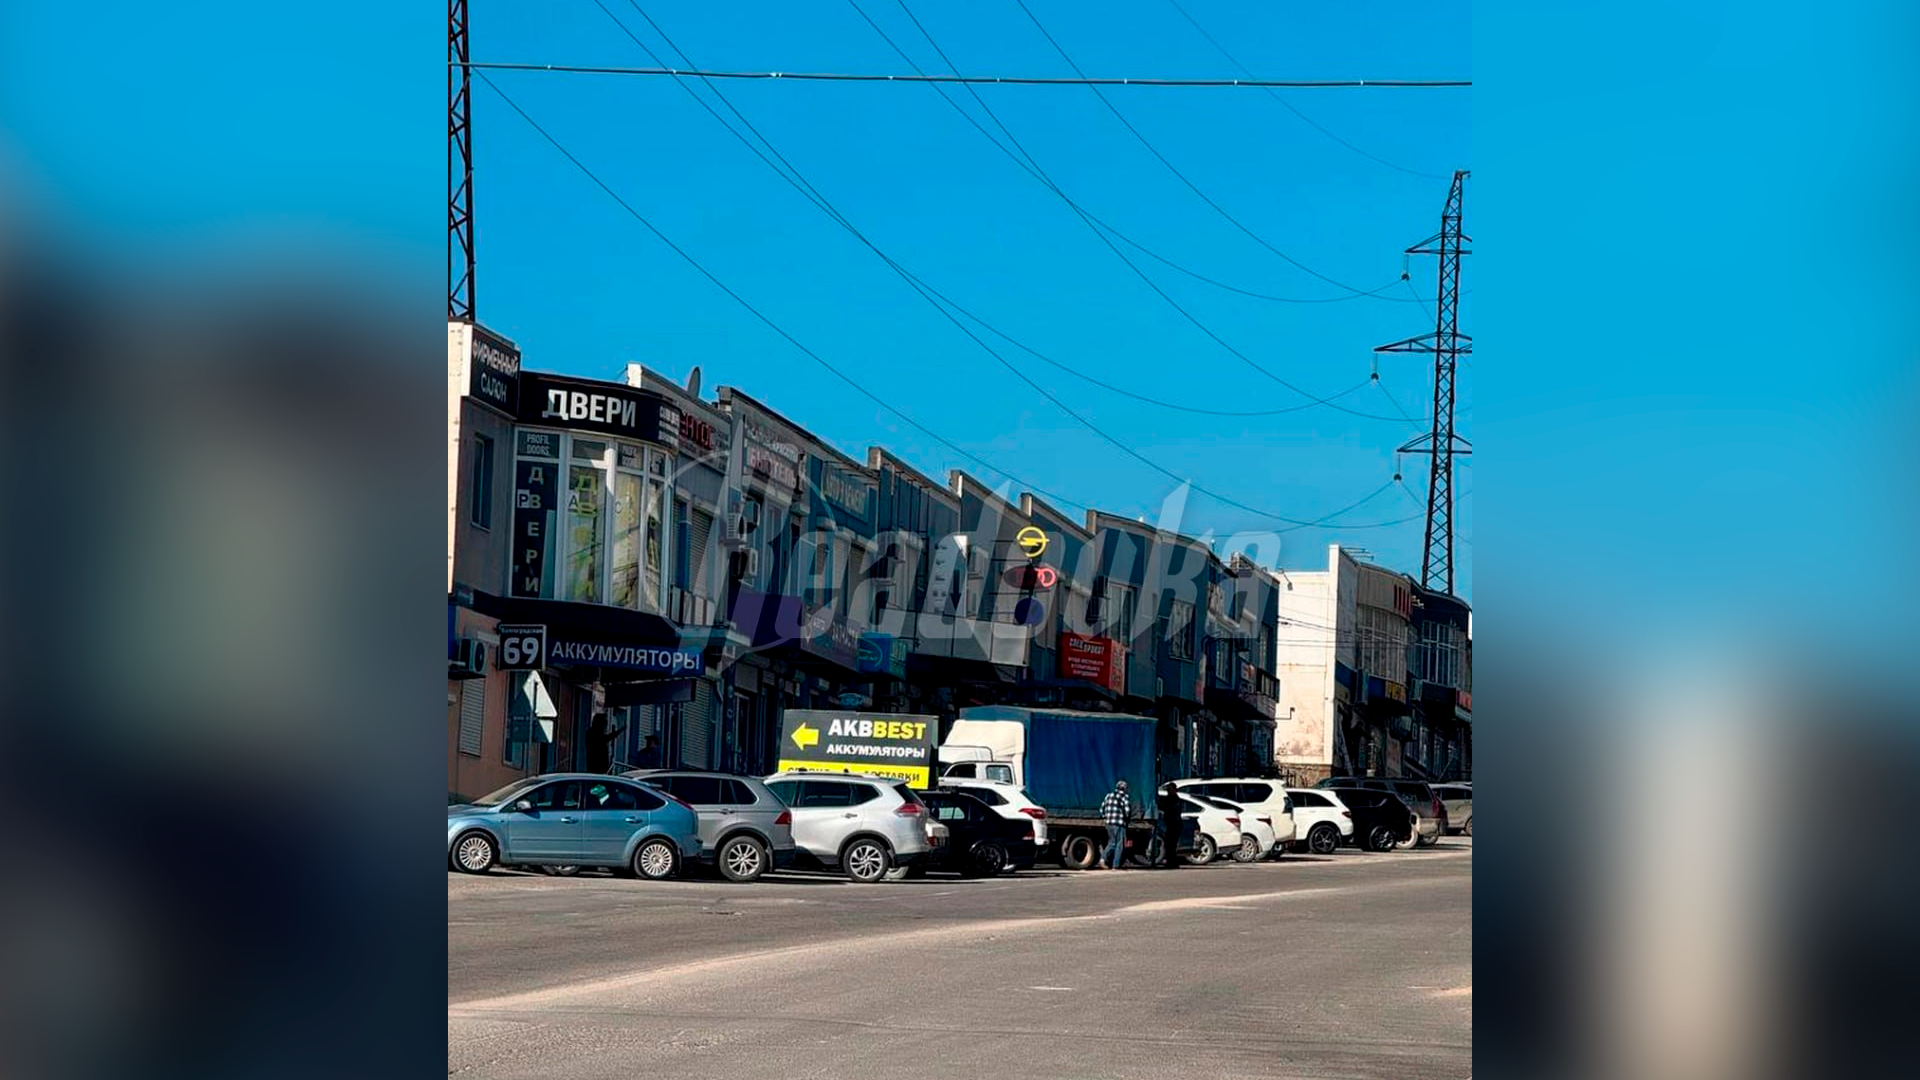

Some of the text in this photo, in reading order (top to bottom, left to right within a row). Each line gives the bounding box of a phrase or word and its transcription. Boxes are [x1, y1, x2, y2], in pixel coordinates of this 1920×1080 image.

[481, 372, 508, 404] САЛОН
[542, 389, 637, 428] ДВЕРИ
[503, 636, 539, 665] 69
[551, 641, 701, 670] АККУМУЛЯТОРЫ
[826, 743, 925, 758] АККУМУЛЯТОРЫ
[864, 768, 920, 783] ОСТАВКИ
